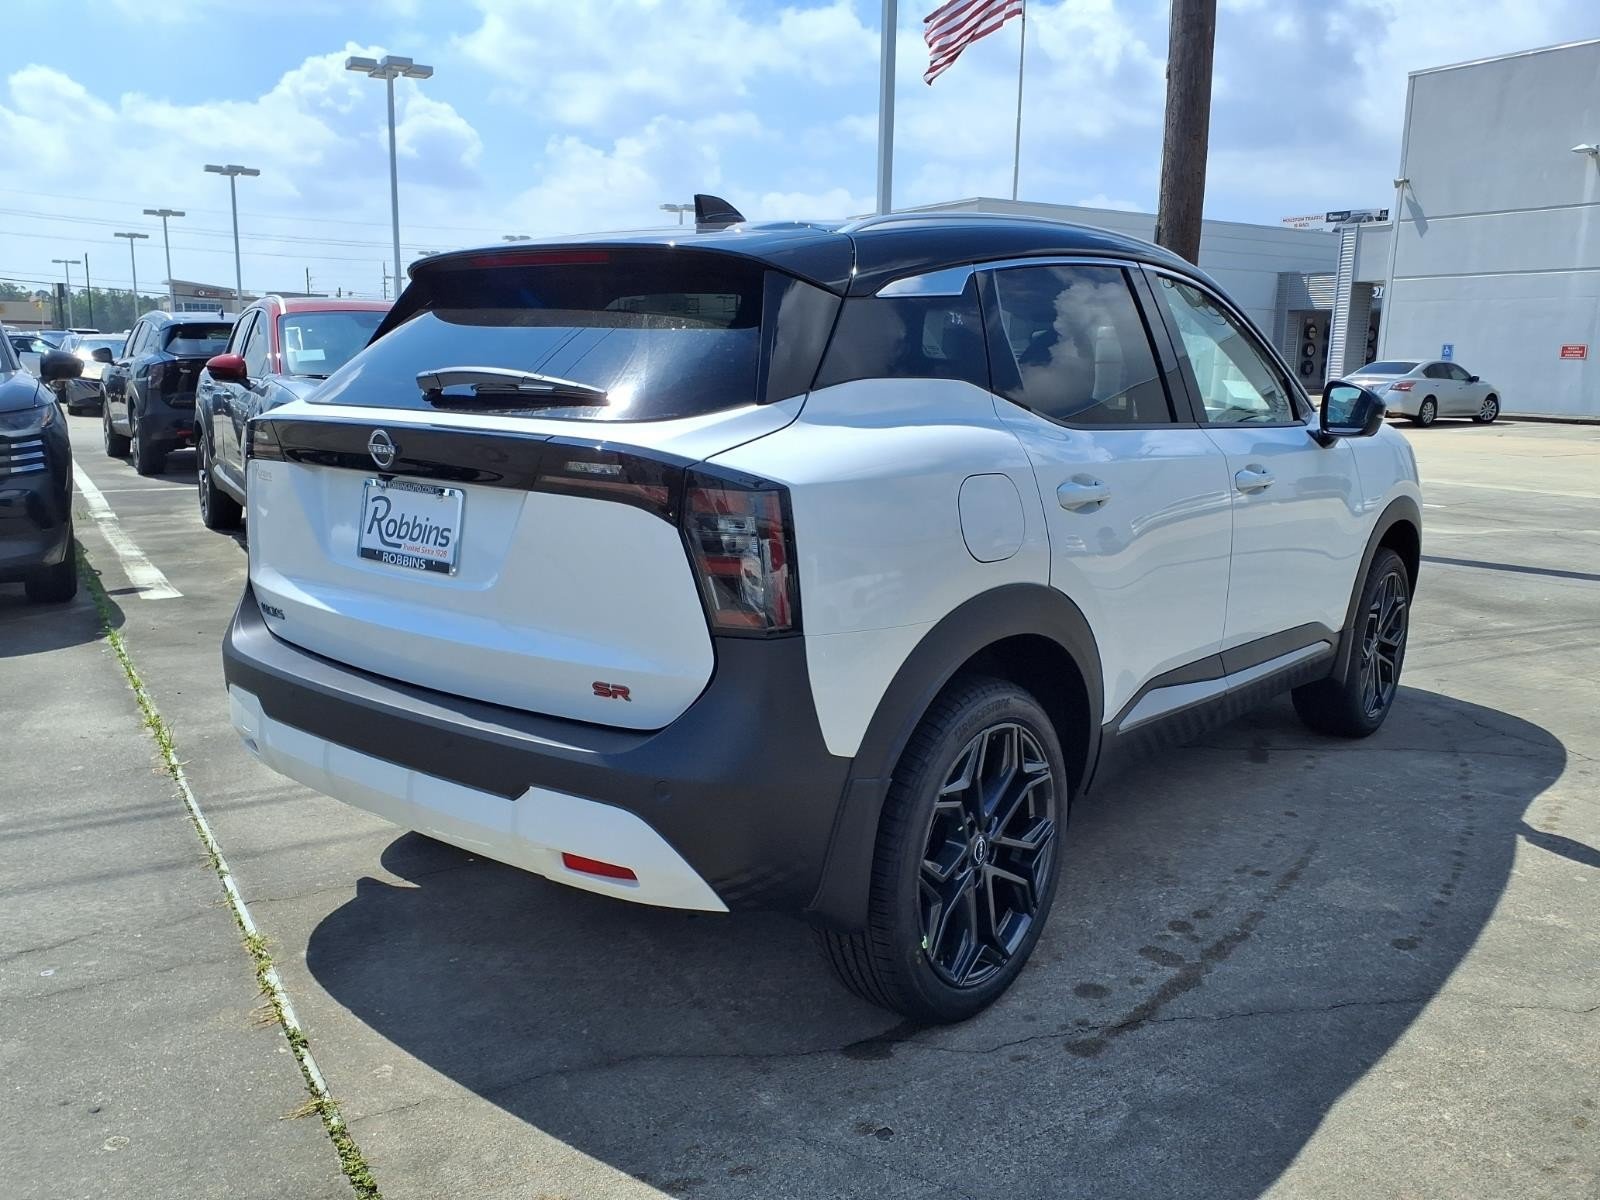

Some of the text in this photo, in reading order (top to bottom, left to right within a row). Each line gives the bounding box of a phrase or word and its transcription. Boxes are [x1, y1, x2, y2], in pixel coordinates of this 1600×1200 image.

[368, 444, 395, 456] NISSAN
[367, 495, 451, 549] Robbins
[403, 543, 448, 558] Trusted Since 1928
[382, 551, 426, 570] ROBBINS
[592, 681, 632, 702] SR
